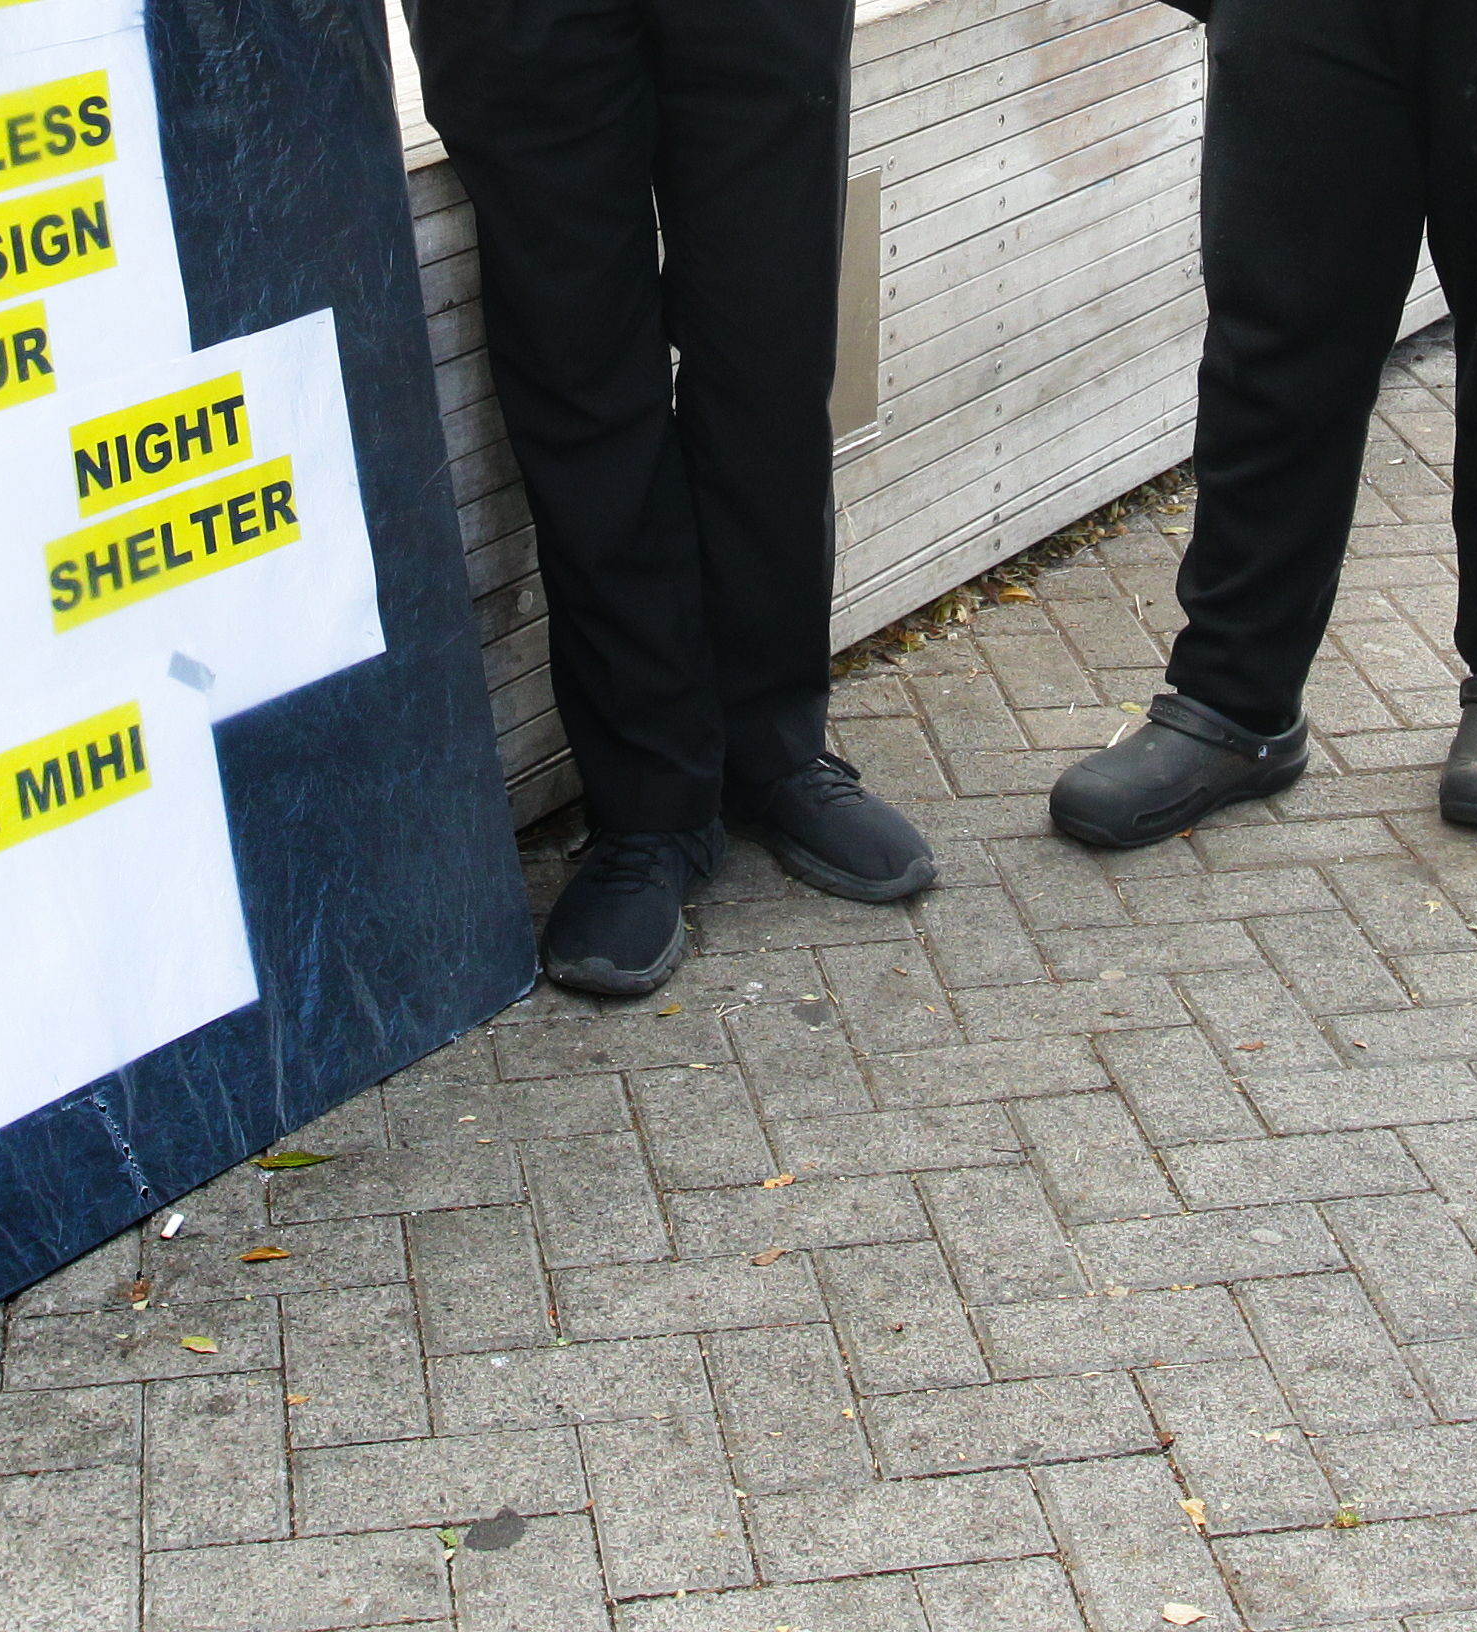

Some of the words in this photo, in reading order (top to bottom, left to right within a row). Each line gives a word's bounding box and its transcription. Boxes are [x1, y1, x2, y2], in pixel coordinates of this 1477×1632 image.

[73, 394, 246, 499] NIGHT
[49, 479, 298, 612] SHELTER
[16, 724, 147, 820] MIHI
